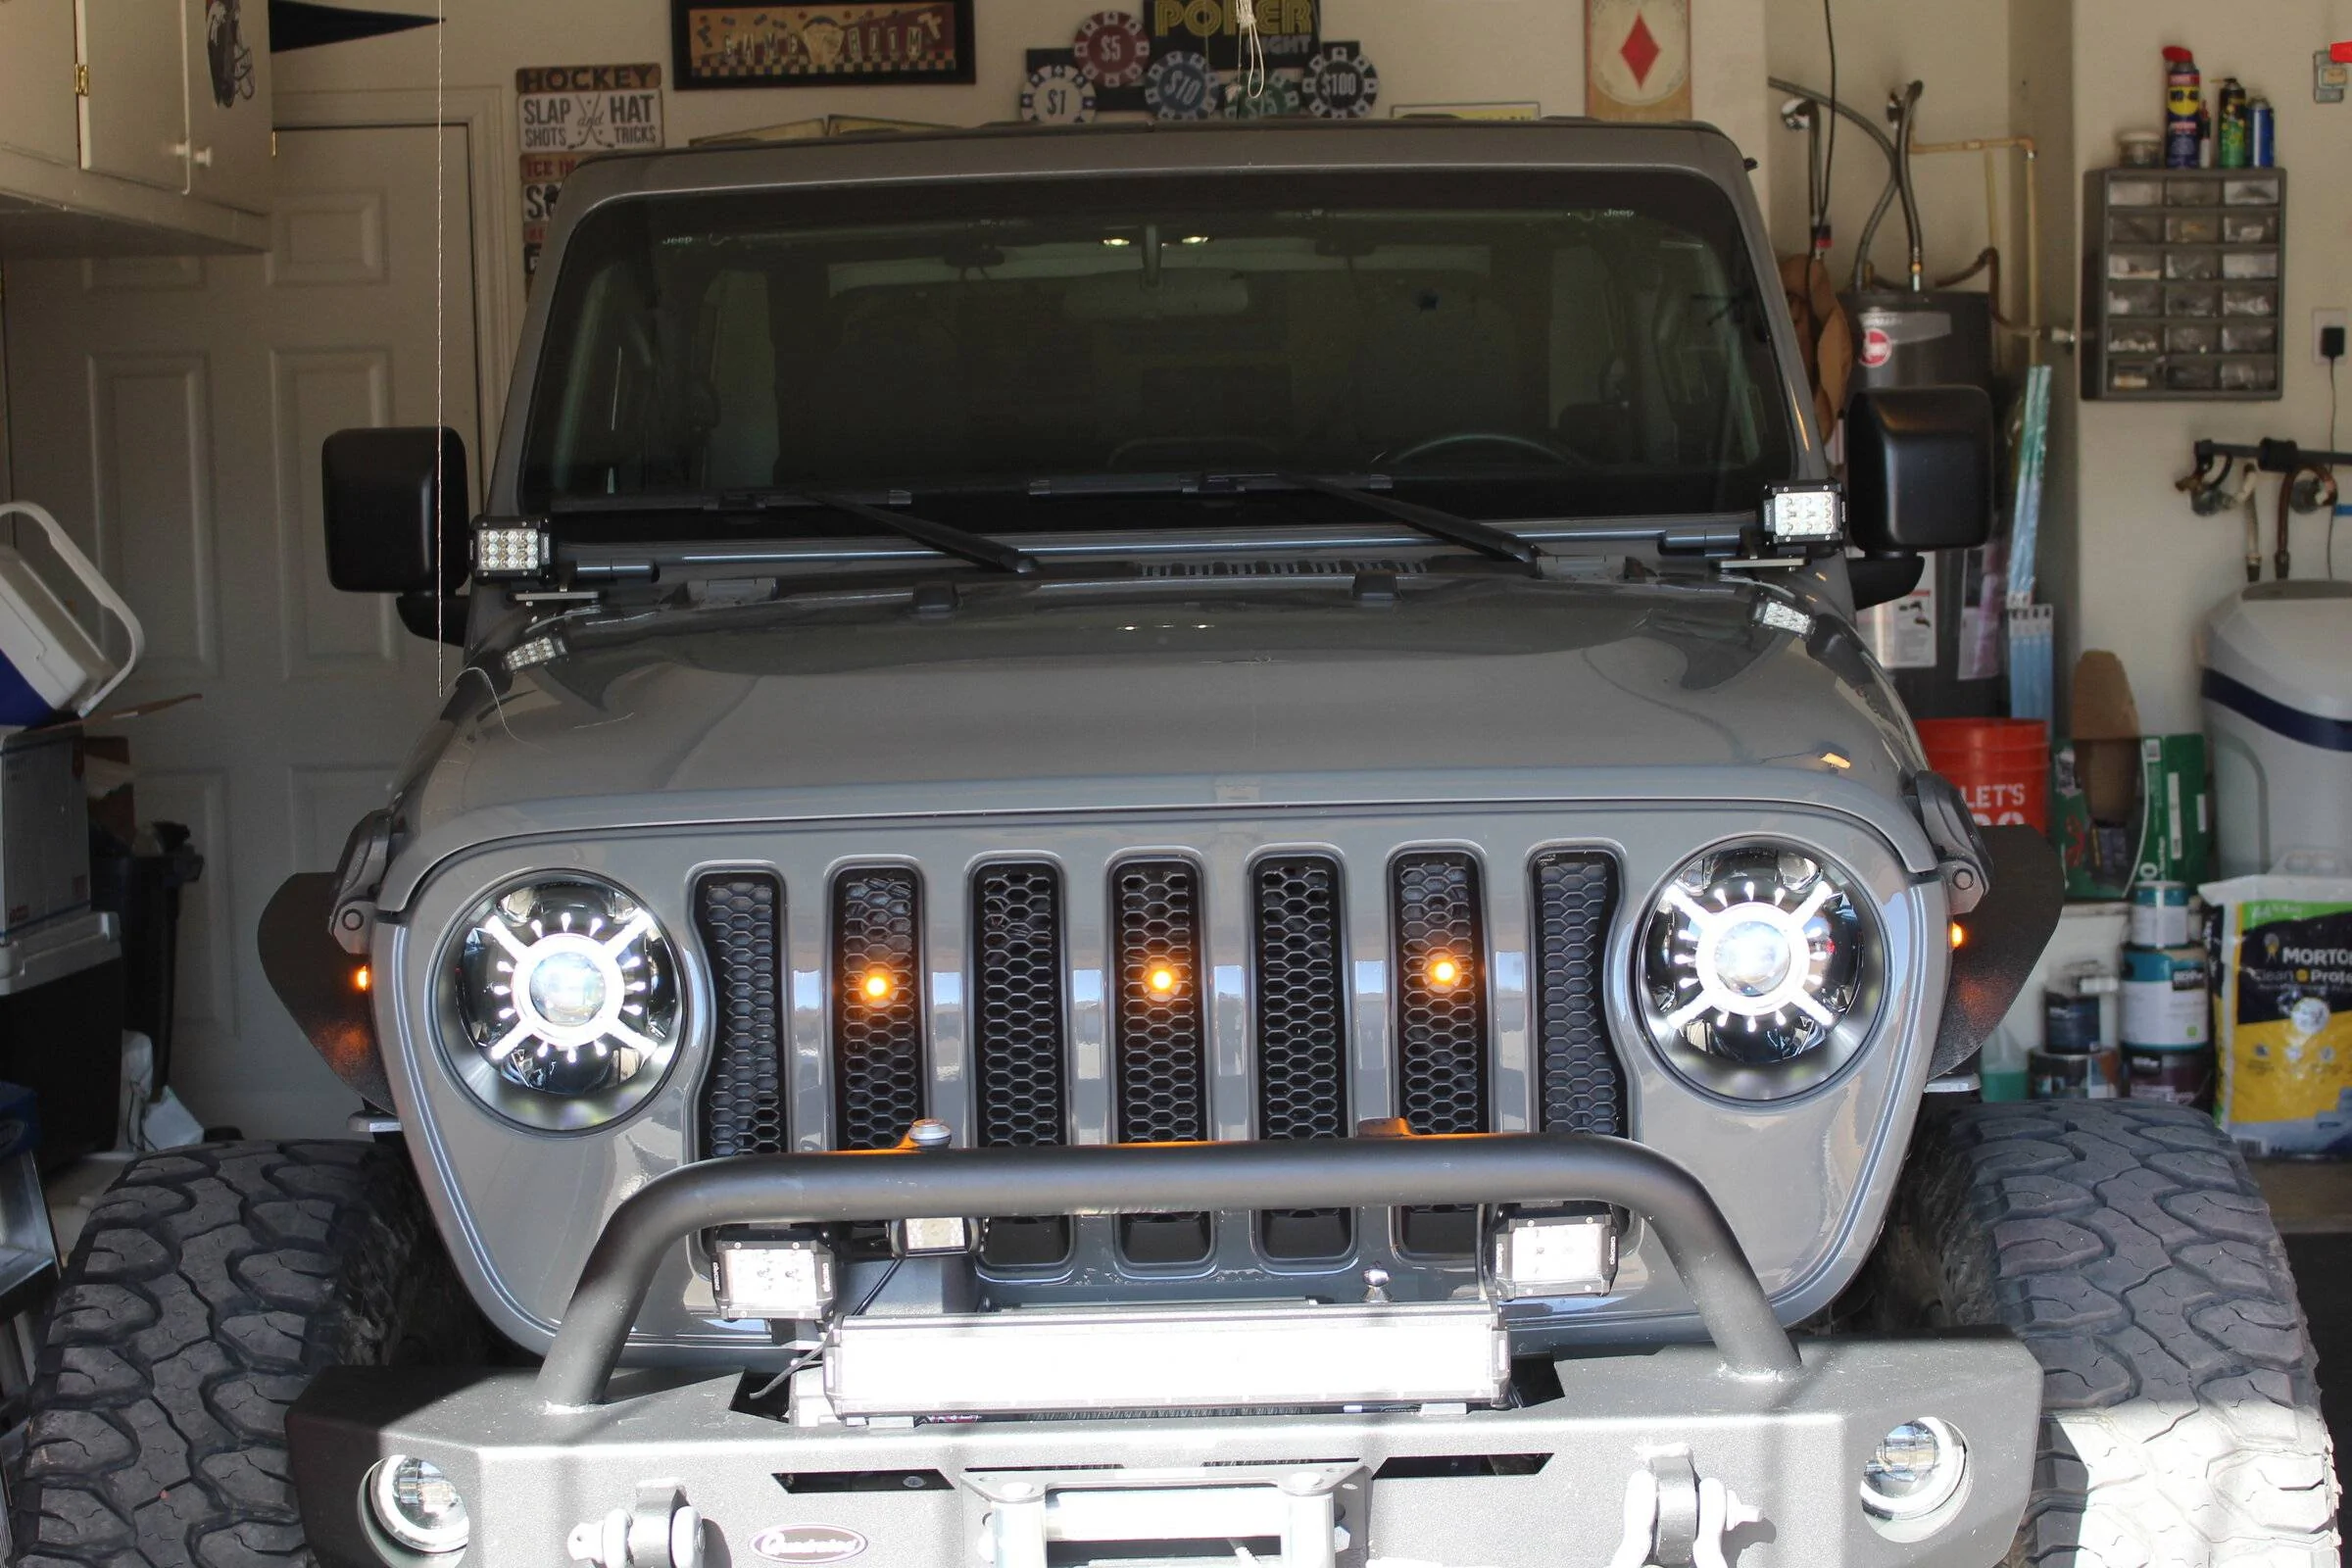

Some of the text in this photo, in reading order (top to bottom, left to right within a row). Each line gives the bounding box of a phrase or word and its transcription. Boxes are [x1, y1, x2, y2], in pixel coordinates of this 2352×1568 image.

[1101, 34, 1122, 63] $5
[523, 65, 653, 91] HOCKEY
[1163, 71, 1199, 105] $10
[1319, 71, 1357, 96] $100
[523, 95, 655, 126] SLAP and HAT
[1047, 88, 1066, 116] $1
[524, 124, 657, 148] SHOTS TRICKS
[527, 160, 554, 177] ICE
[1960, 782, 2026, 808] LET'S
[2282, 946, 2352, 967] MORTO
